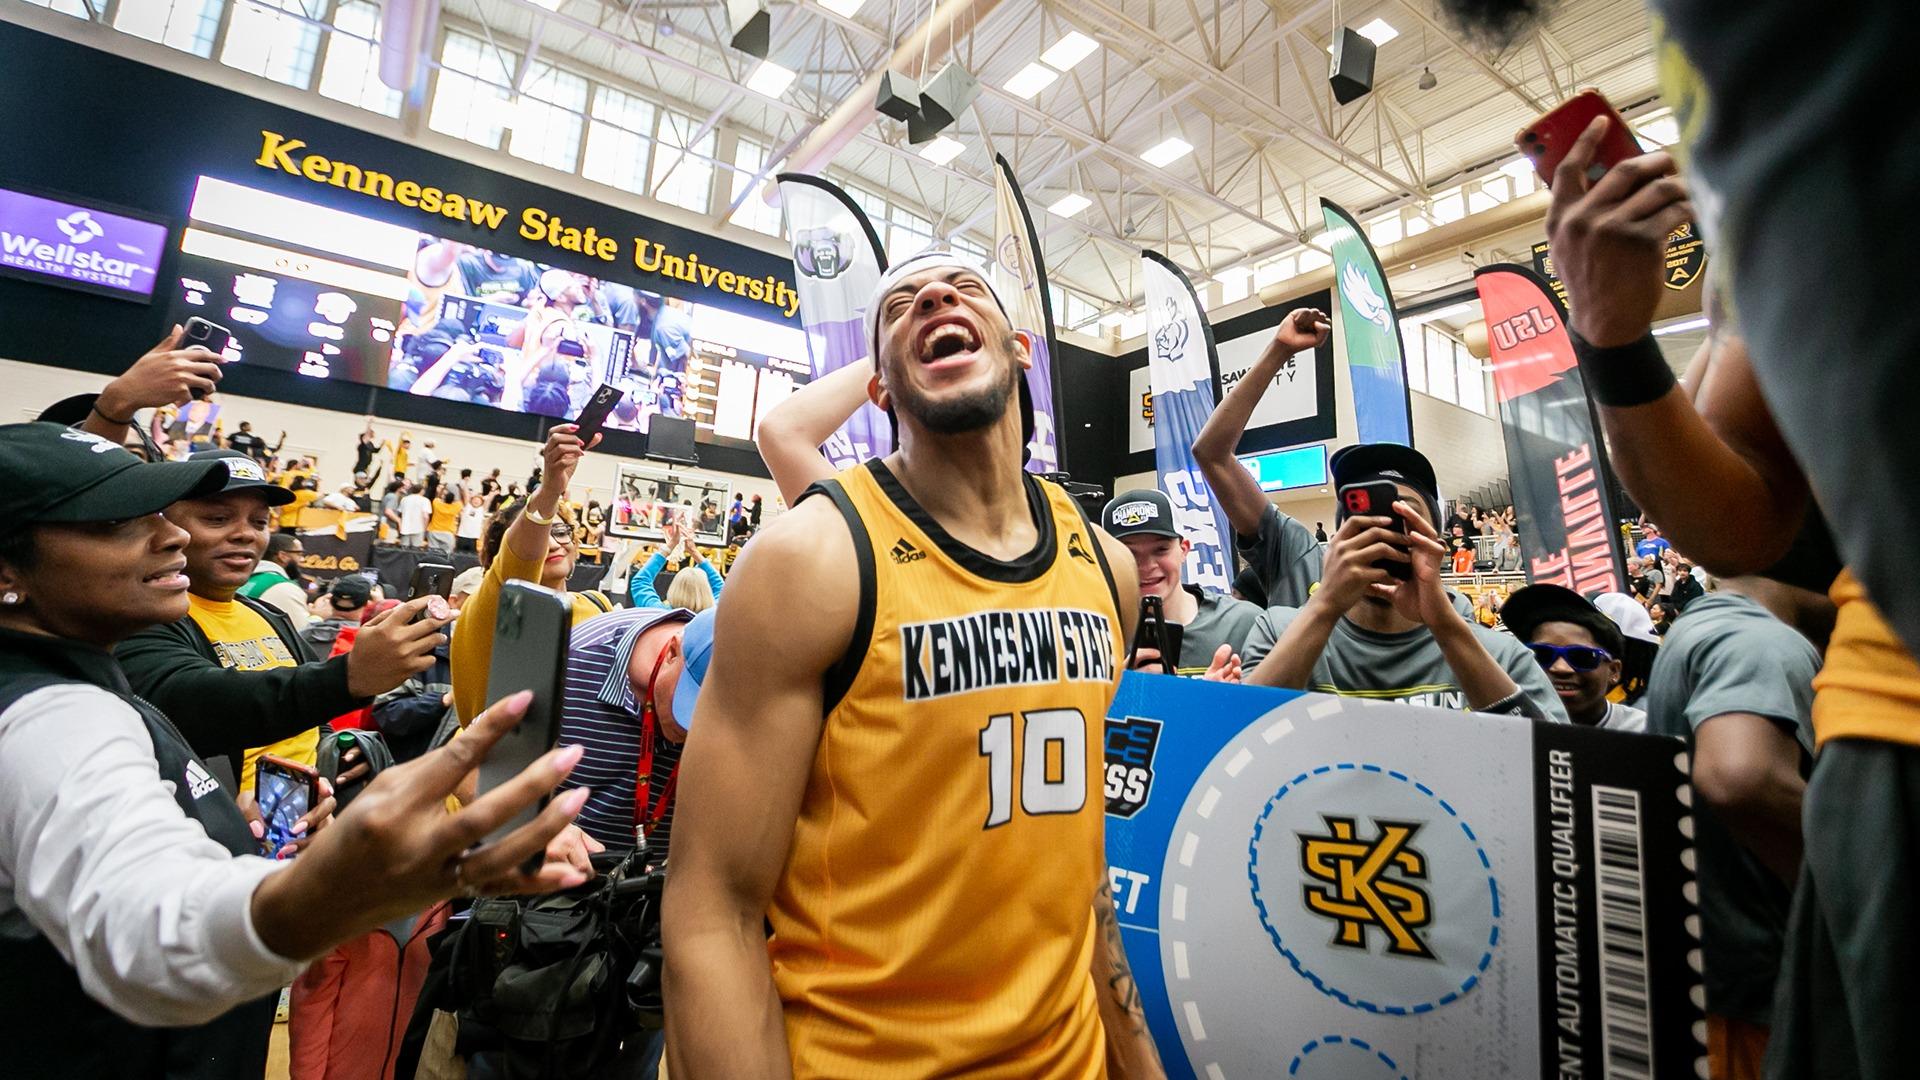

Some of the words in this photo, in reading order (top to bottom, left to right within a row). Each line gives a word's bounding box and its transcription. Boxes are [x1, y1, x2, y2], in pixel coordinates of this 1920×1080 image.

[1, 231, 141, 278] Wellstar
[255, 130, 508, 231] Kennesaw
[519, 207, 619, 262] State
[633, 237, 801, 318] University
[900, 611, 1060, 700] KENNESAW
[1057, 609, 1115, 684] STATE
[978, 707, 1088, 831] 10
[1104, 763, 1148, 804] SS
[1549, 750, 1580, 879] QUALIFIER
[1552, 881, 1581, 1037] AUTOMATIC
